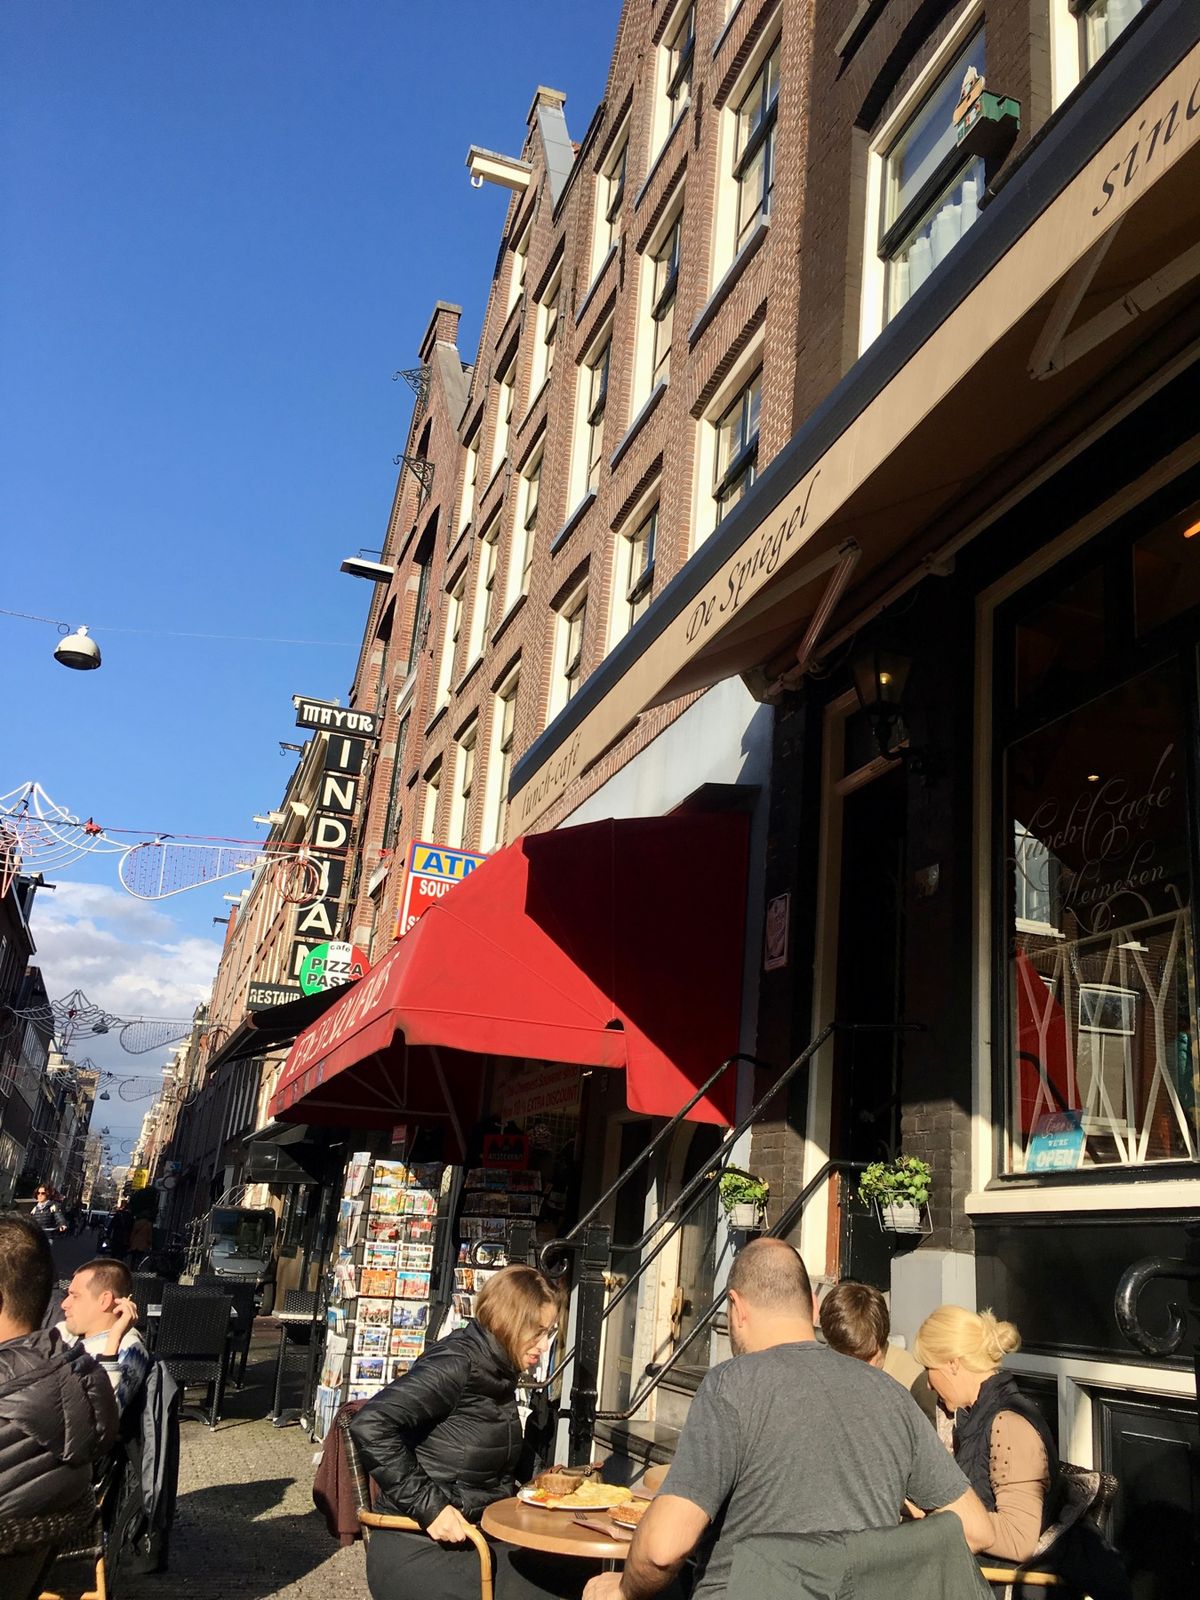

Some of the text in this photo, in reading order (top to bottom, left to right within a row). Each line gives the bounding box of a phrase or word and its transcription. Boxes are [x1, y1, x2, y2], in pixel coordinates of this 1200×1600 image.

[686, 469, 821, 645] De Spiegel
[303, 704, 374, 733] MAYUR
[1054, 840, 1166, 930] Heineken
[311, 957, 363, 977] PIZZA
[249, 988, 305, 1006] RESTAUR
[546, 1084, 578, 1107] DISCOUNT
[1035, 1148, 1074, 1168] OPEN
